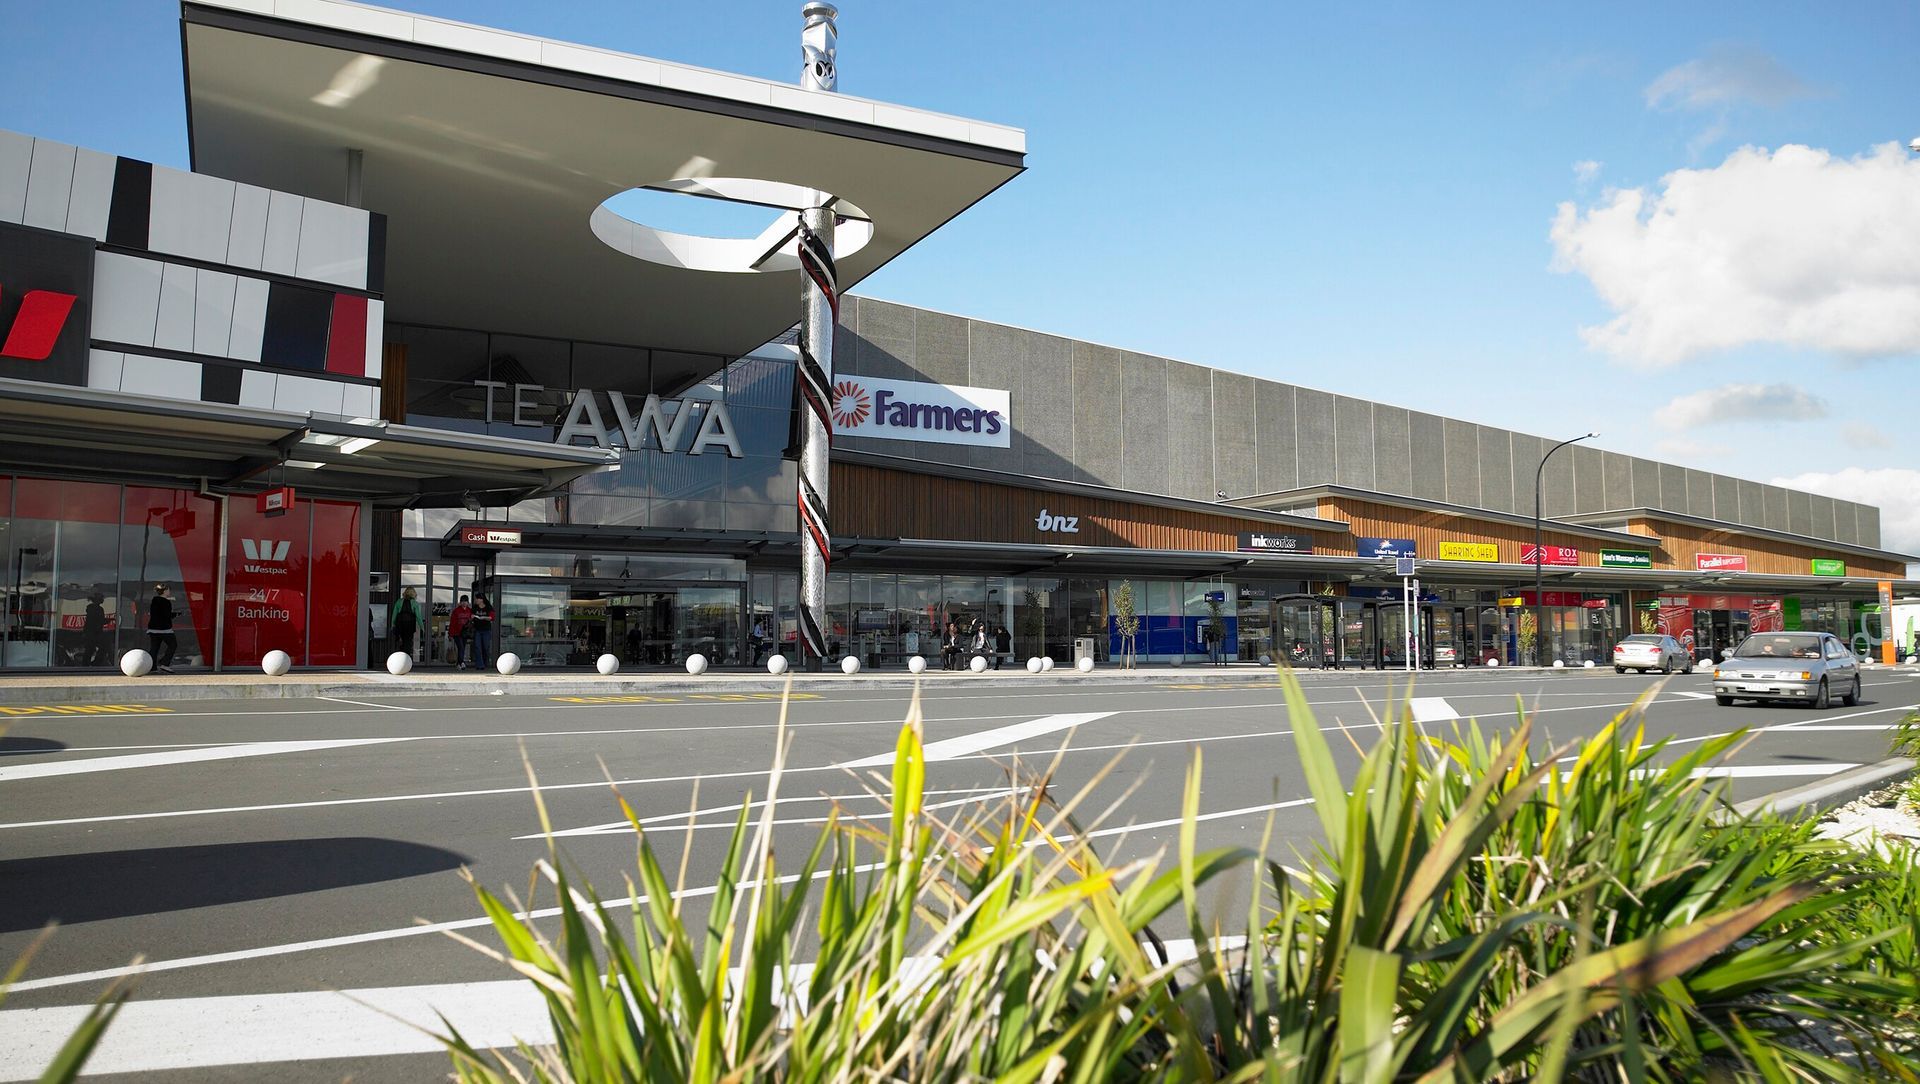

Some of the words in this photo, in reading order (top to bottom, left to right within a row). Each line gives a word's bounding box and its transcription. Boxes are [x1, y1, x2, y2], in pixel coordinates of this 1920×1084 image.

[474, 380, 544, 428] TE
[555, 388, 745, 458] AWA
[874, 389, 1002, 436] Farmers
[1034, 508, 1080, 534] bnz
[467, 533, 486, 541] Cash
[489, 535, 518, 543] Westpac
[1251, 534, 1297, 549] inkworks
[1444, 544, 1474, 557] SHARING
[1477, 545, 1494, 559] SHED
[1558, 548, 1577, 558] ROX
[244, 564, 288, 574] Westpac
[1700, 557, 1722, 568] Parallel
[249, 588, 280, 603] 24/7
[237, 606, 290, 622] Banking
